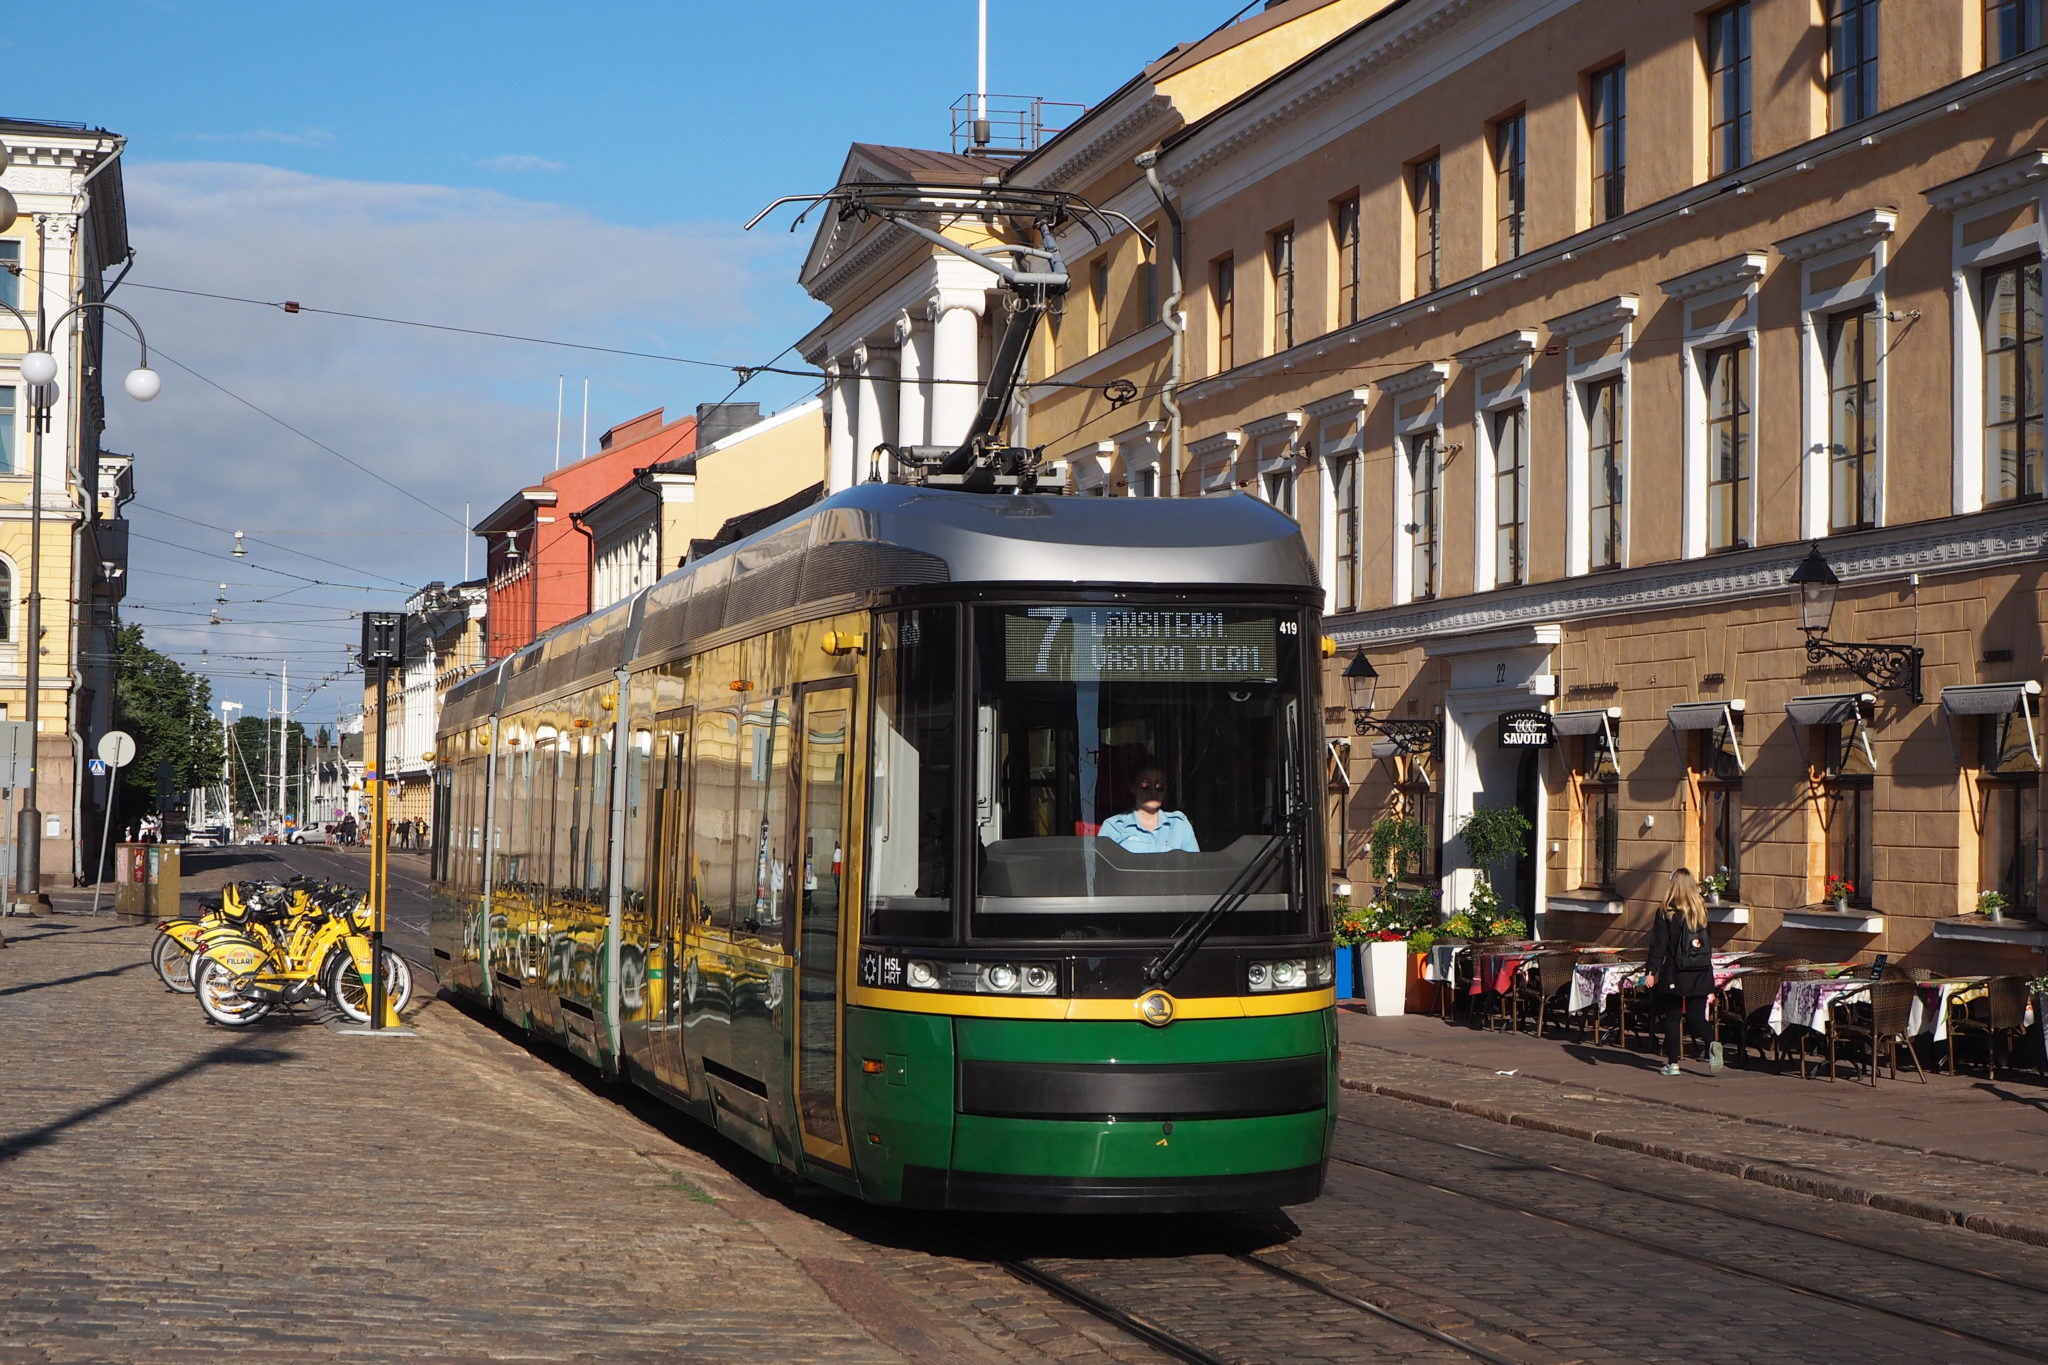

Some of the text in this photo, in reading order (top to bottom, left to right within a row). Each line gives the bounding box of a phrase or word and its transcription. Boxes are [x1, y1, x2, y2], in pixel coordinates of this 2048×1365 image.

[1279, 621, 1298, 635] 419
[1028, 608, 1067, 673] 7
[1196, 645, 1264, 671] TERM.
[1496, 663, 1506, 683] 22
[1529, 680, 1536, 690] 22
[1503, 732, 1549, 745] SAVOTTA
[884, 957, 901, 971] HSL
[883, 971, 901, 984] HRT
